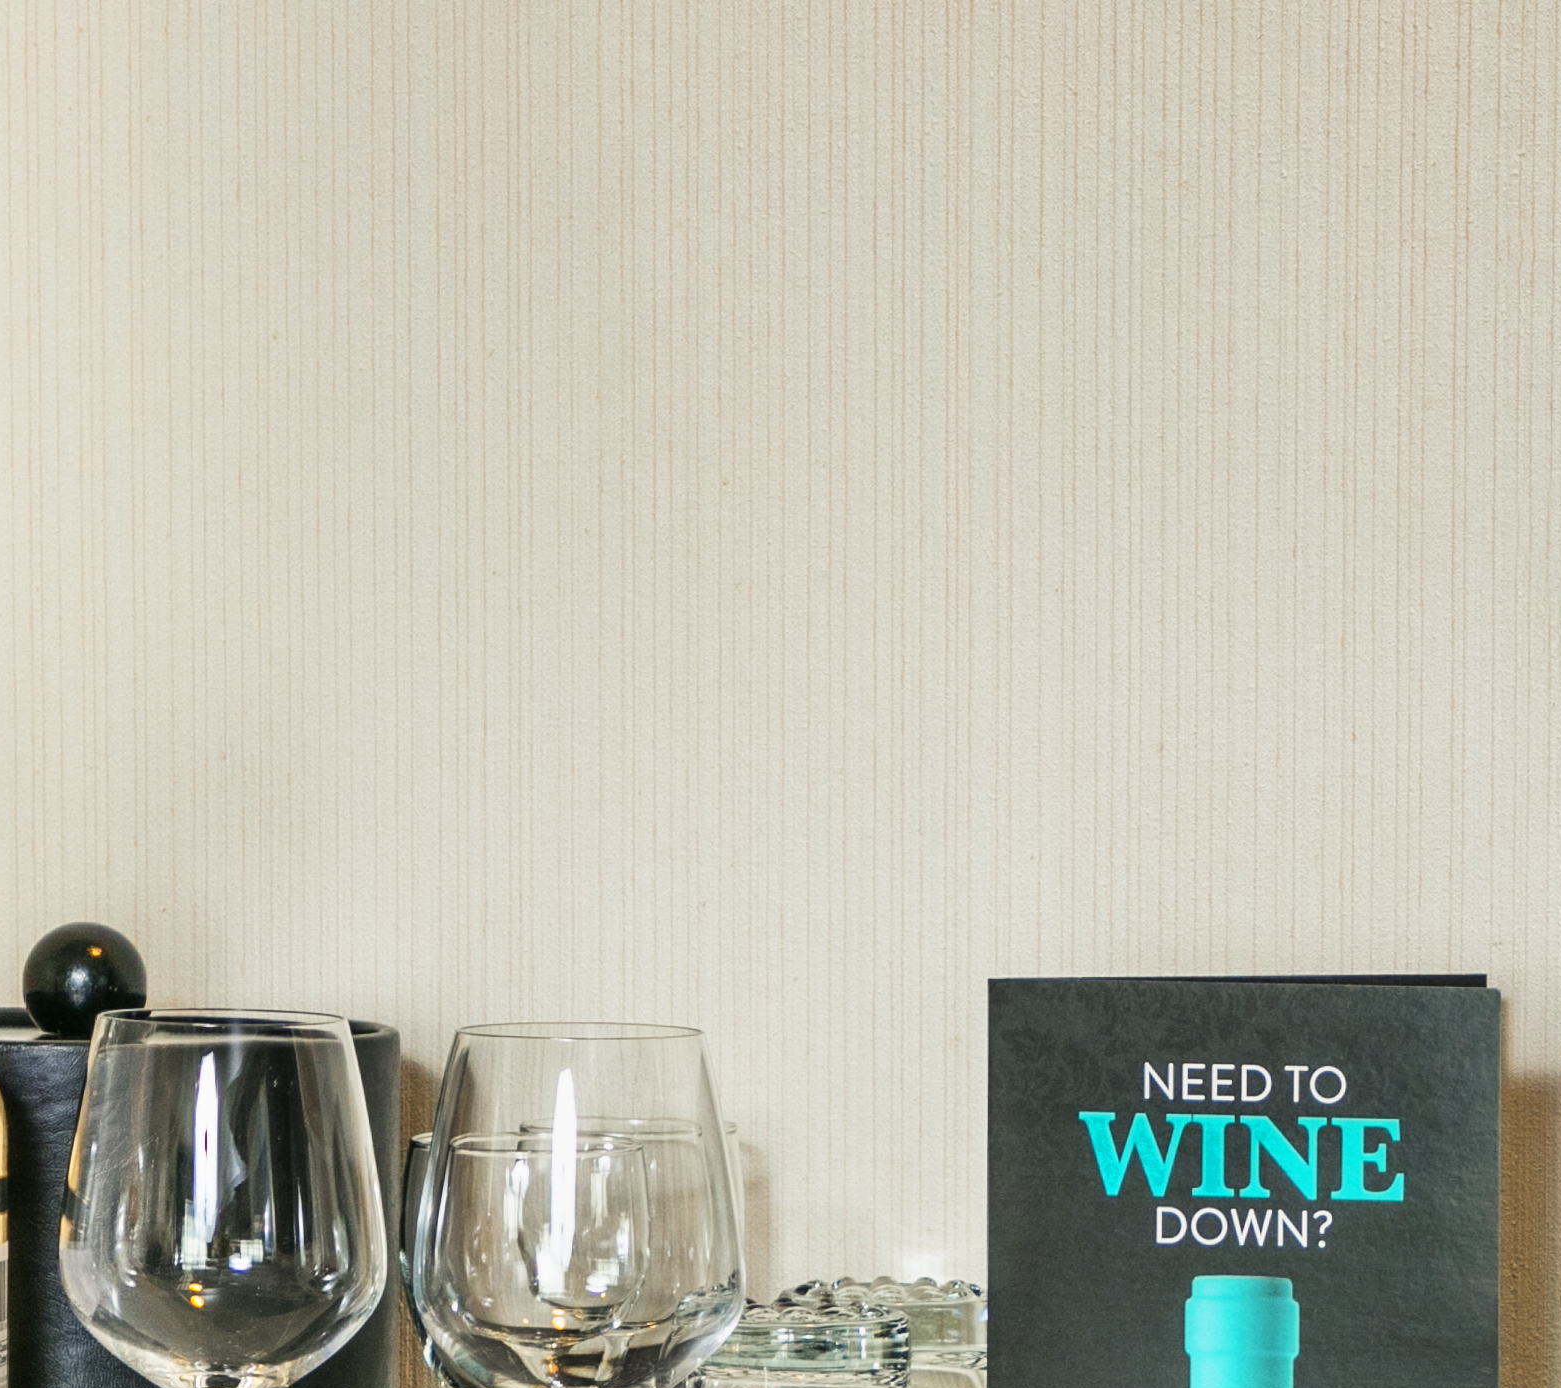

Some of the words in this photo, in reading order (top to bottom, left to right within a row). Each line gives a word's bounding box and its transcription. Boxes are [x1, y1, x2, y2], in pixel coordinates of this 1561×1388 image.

[1143, 1061, 1272, 1102] NEED
[1284, 1064, 1348, 1105] TO
[1078, 1110, 1405, 1202] WINE
[1154, 1205, 1334, 1249] DOWN?
